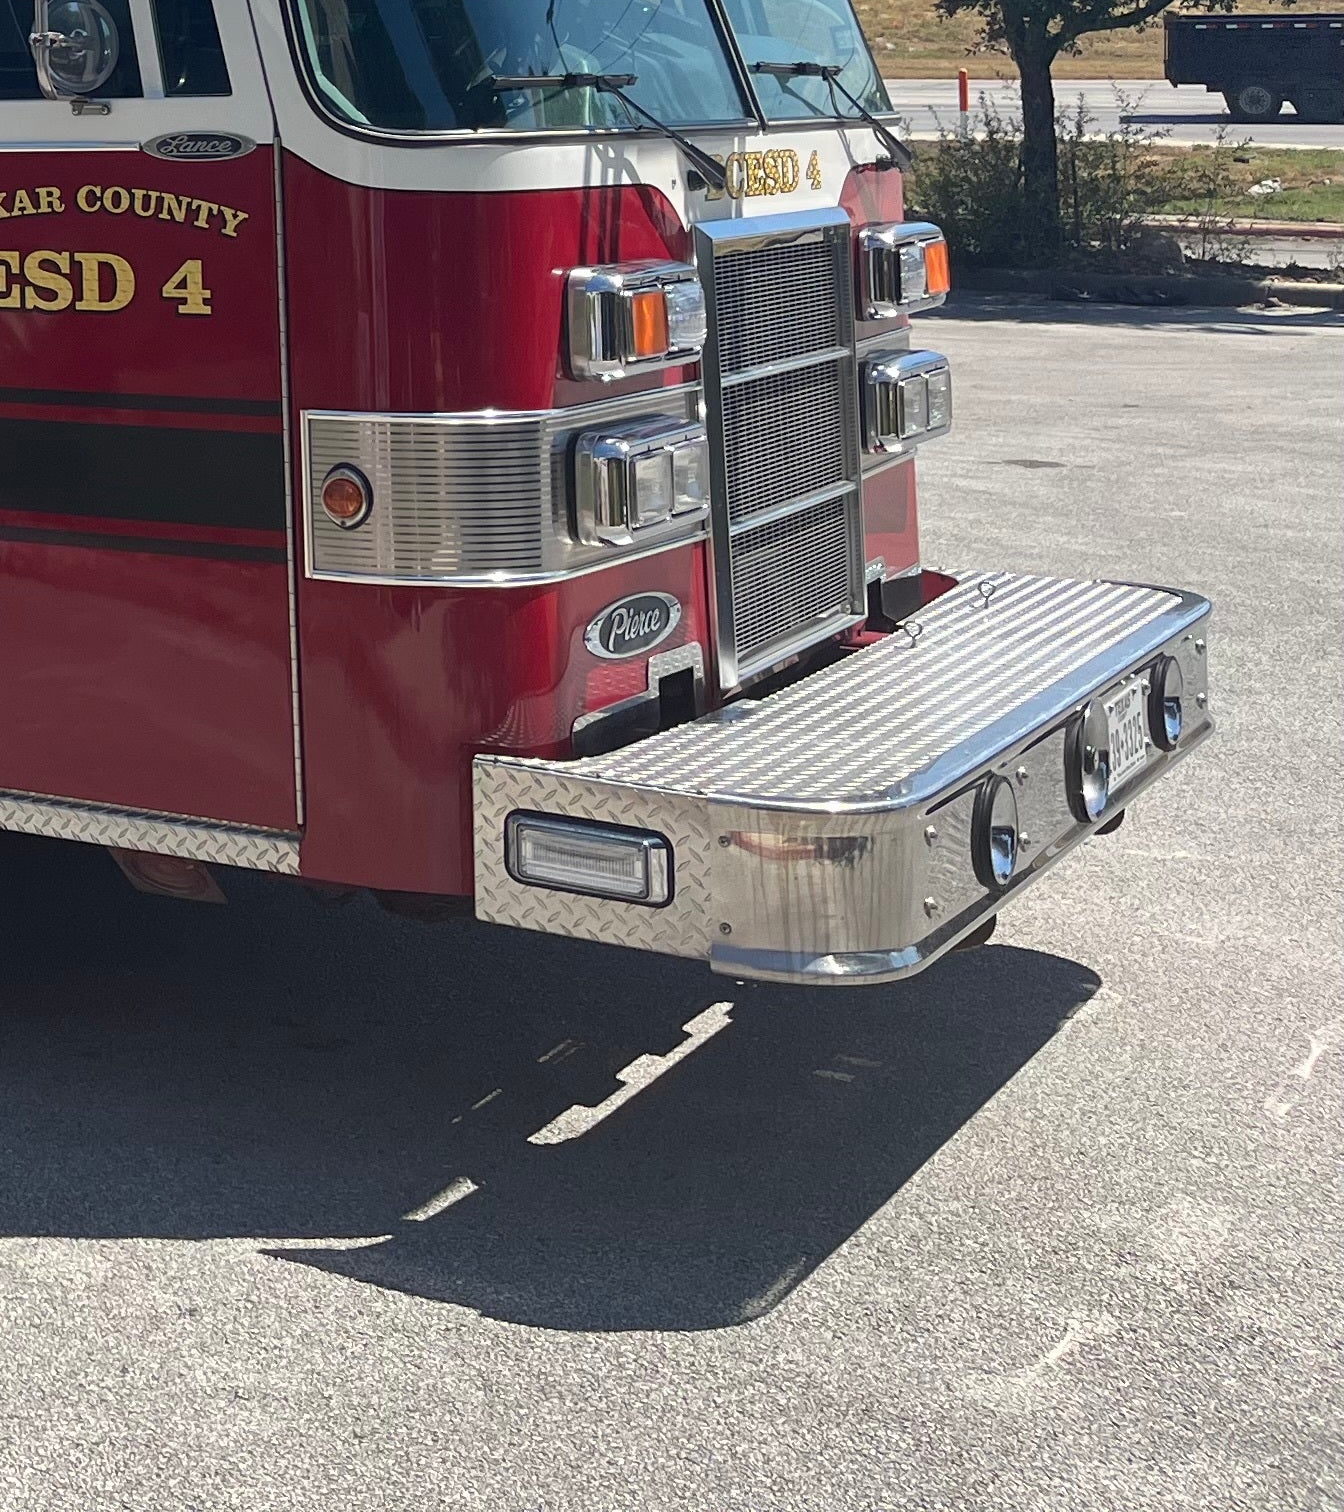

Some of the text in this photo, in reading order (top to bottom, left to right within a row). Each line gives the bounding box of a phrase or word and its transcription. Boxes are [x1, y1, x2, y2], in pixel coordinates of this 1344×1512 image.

[159, 135, 234, 156] Lance
[806, 150, 822, 191] 4
[76, 184, 250, 238] COUNTY
[161, 259, 212, 315] 4
[608, 607, 661, 652] Pierce
